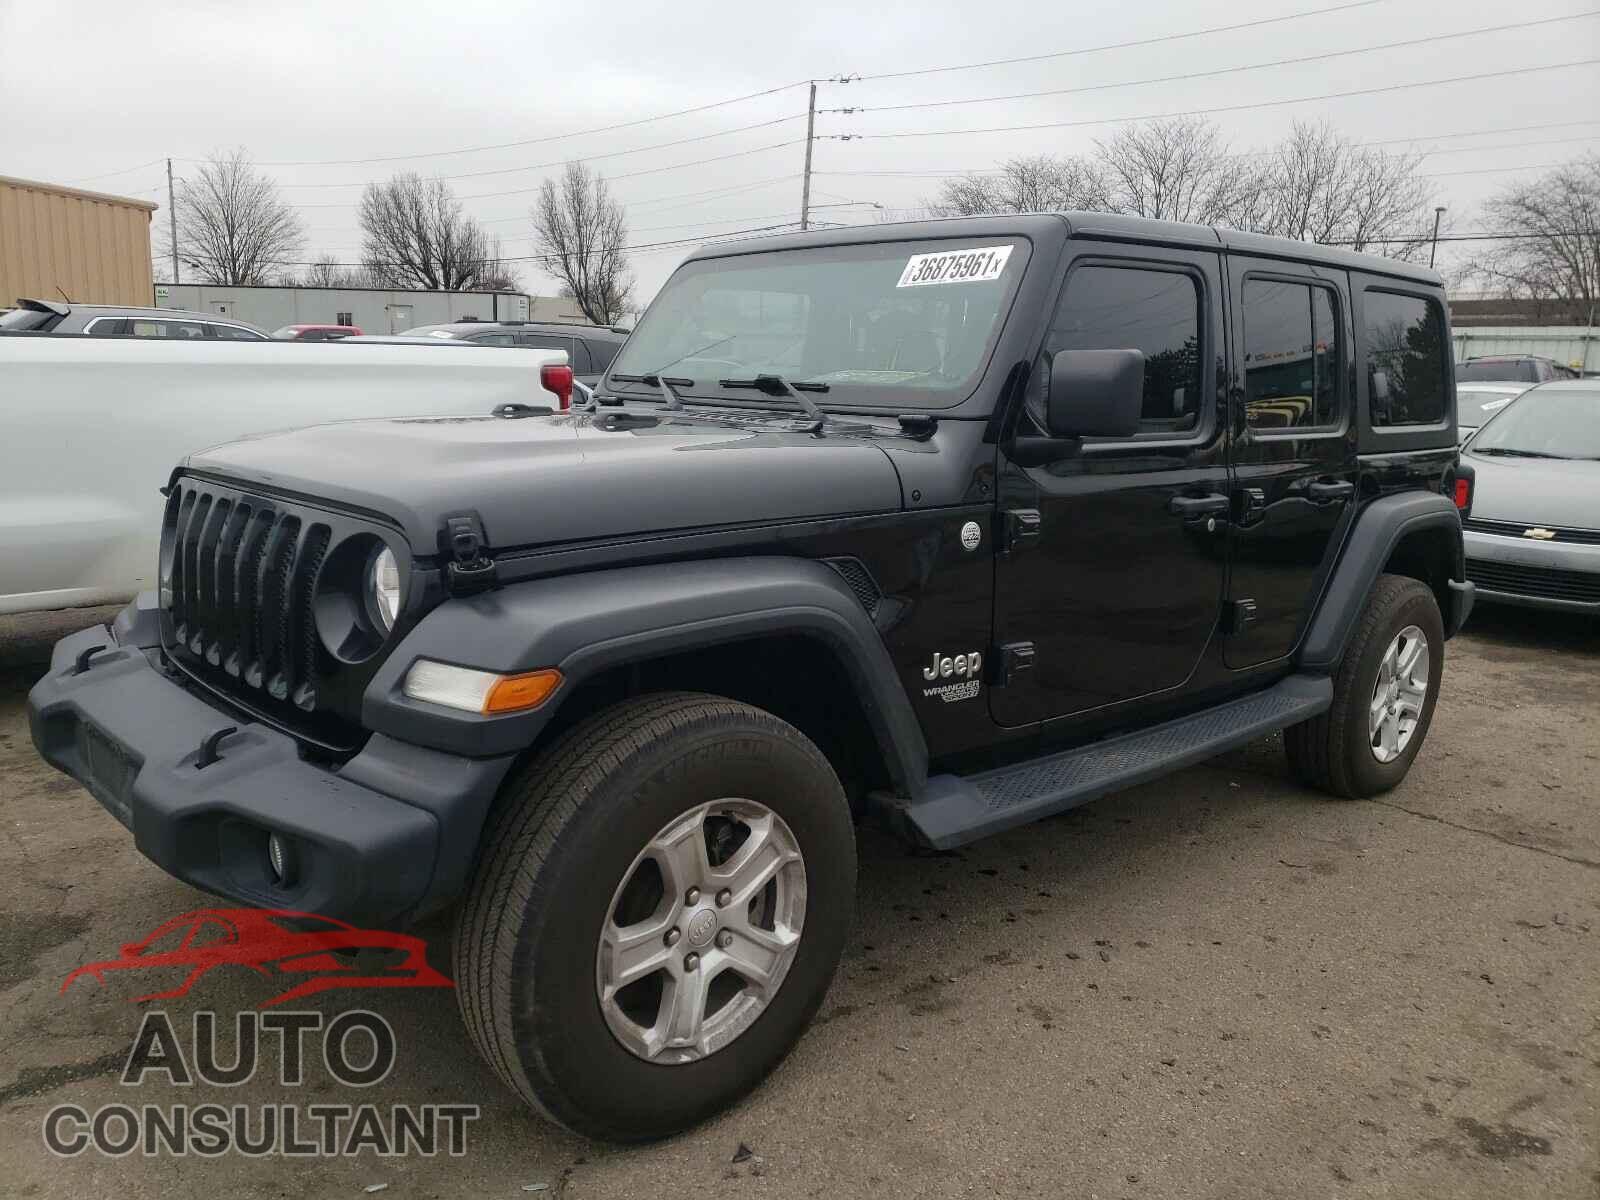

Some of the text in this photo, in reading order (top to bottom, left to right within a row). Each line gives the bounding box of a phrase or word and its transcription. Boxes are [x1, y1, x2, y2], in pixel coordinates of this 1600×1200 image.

[912, 251, 995, 281] 36875961
[923, 652, 982, 680] Jeep
[923, 679, 980, 697] WRANGLER
